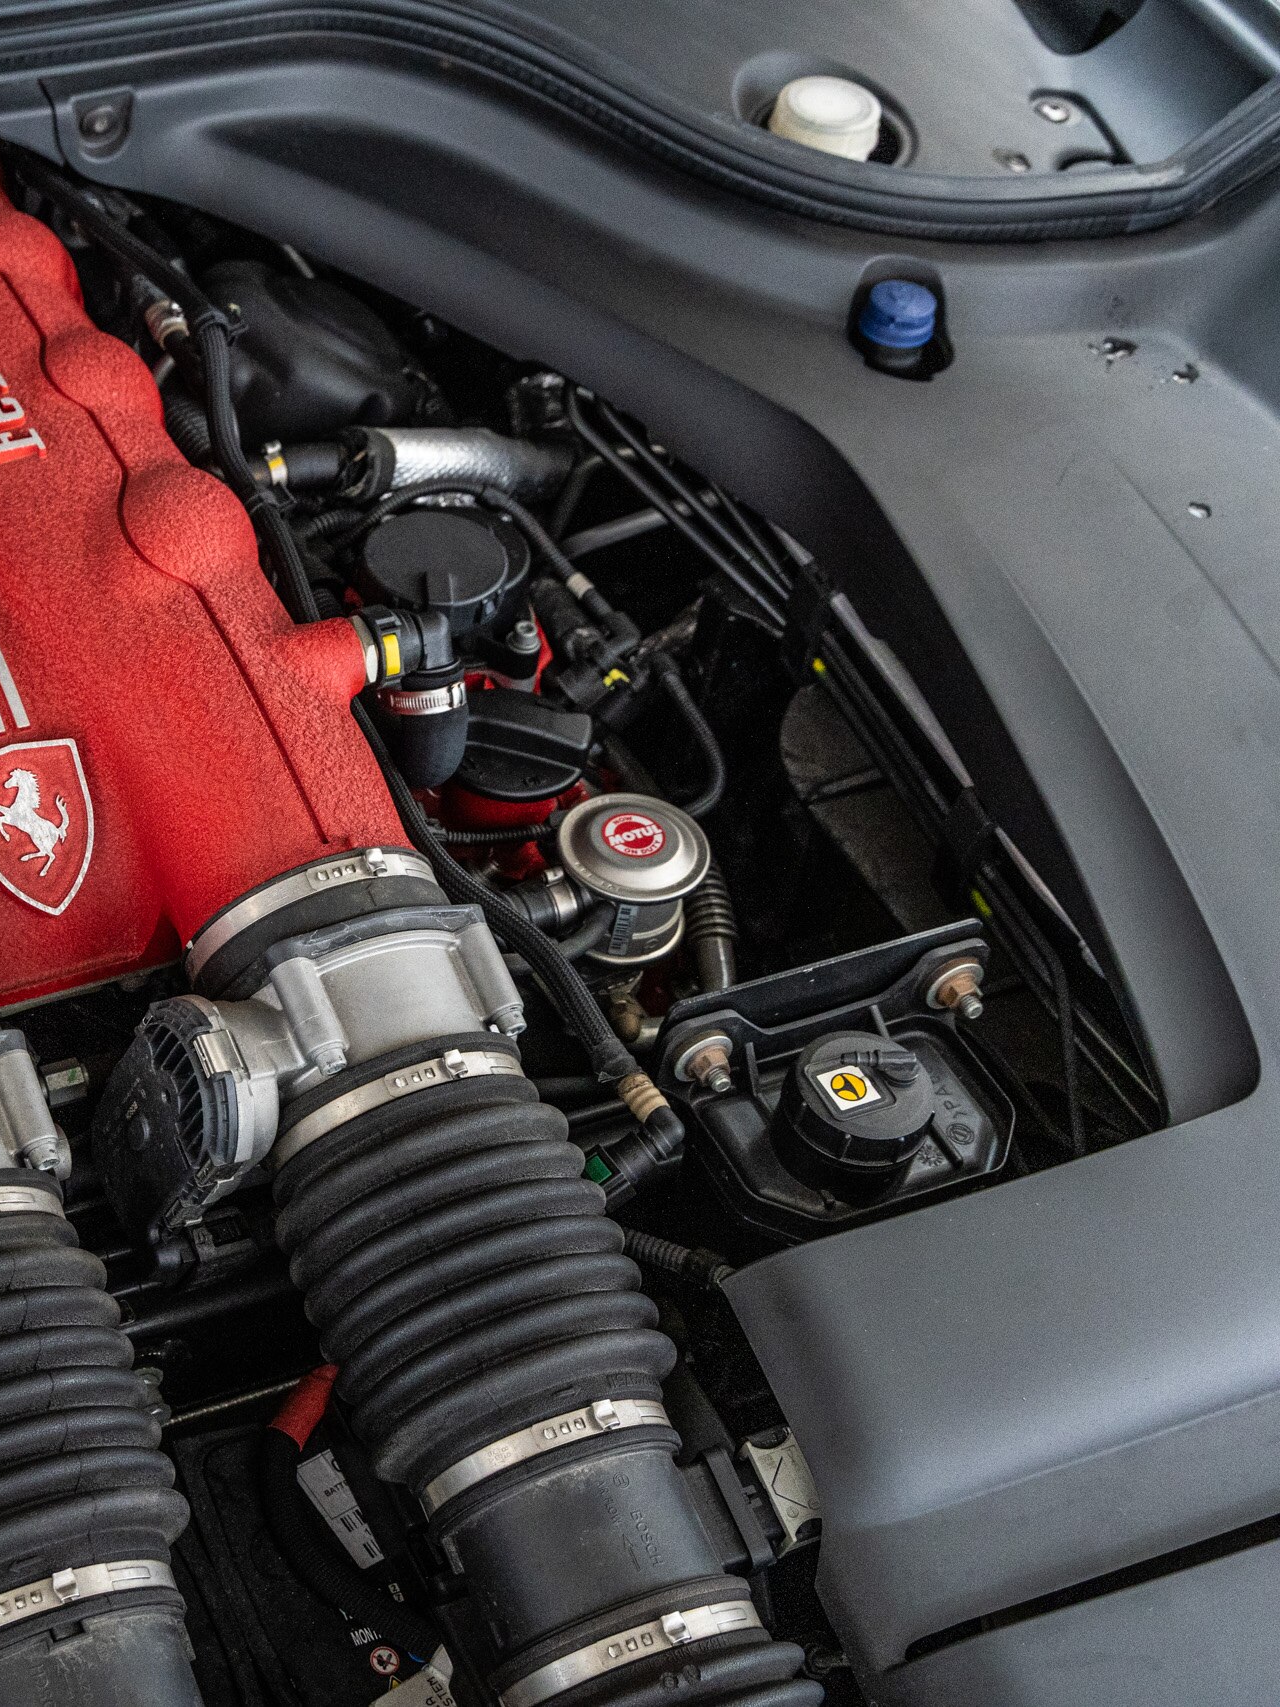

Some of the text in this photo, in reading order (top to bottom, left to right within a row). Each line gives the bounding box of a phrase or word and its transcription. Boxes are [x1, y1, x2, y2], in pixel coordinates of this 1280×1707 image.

[608, 822, 663, 846] MOTUL
[623, 840, 661, 855] ON DUTY
[629, 1507, 662, 1568] BOSCH
